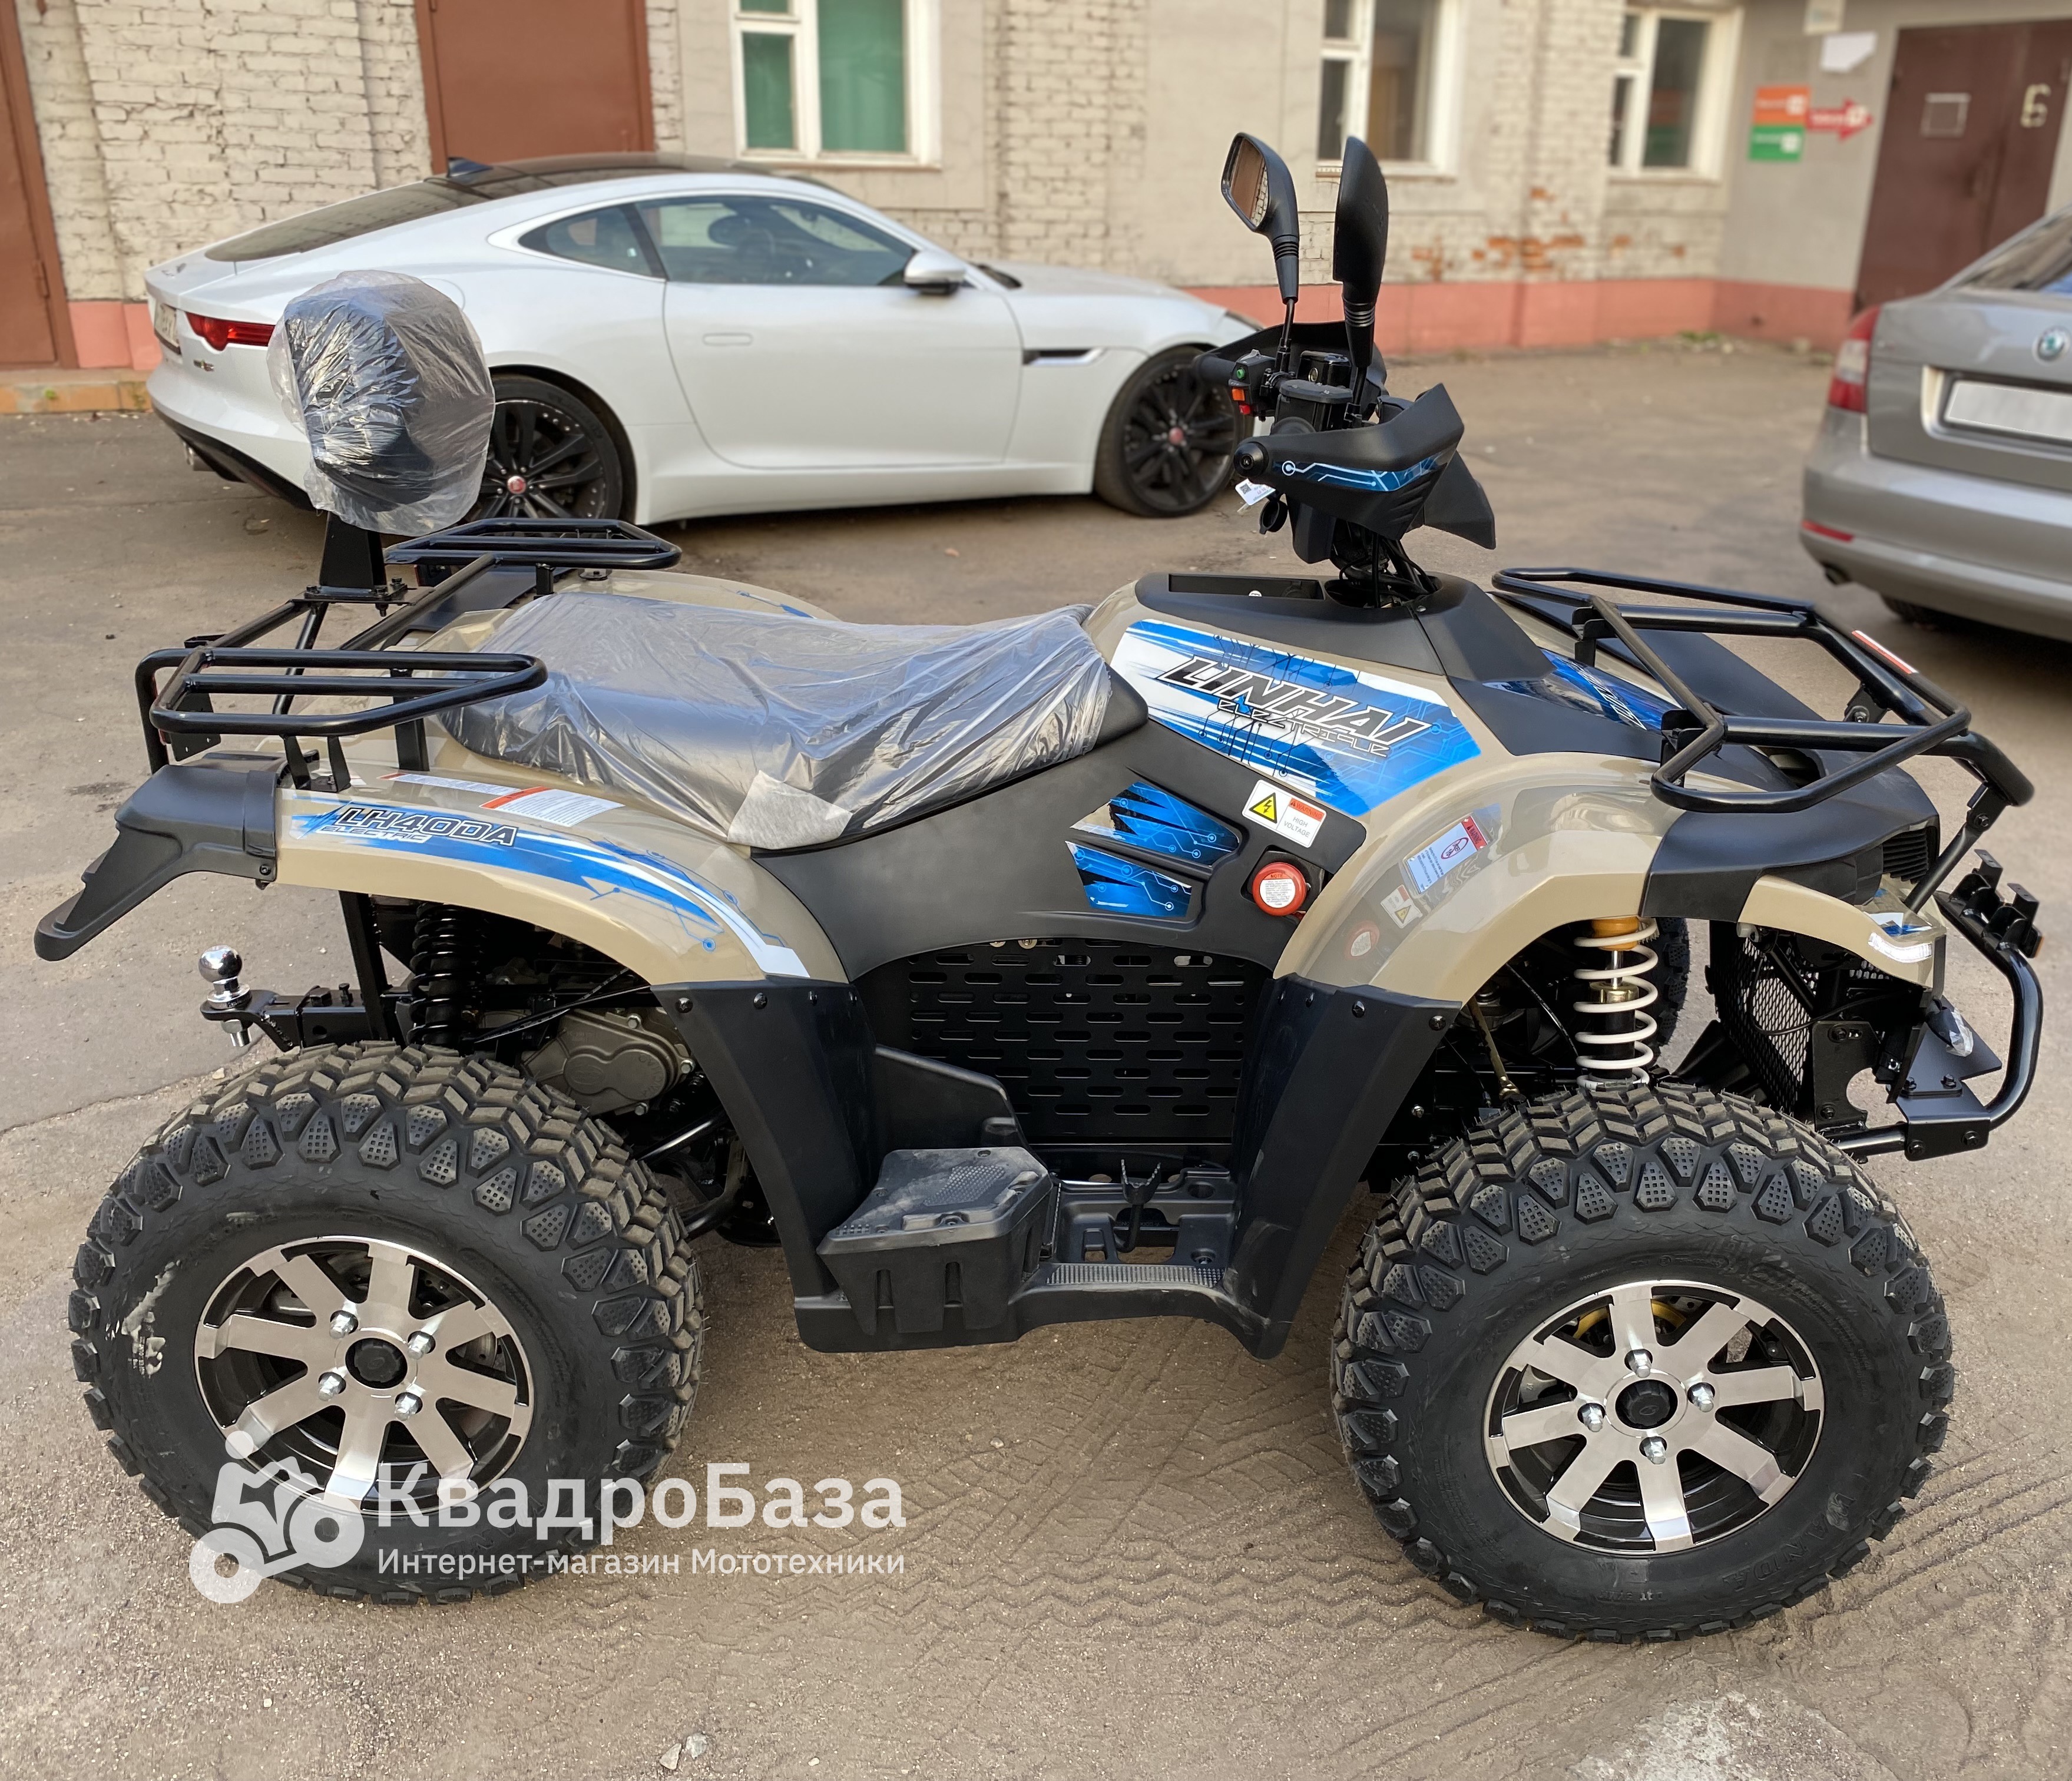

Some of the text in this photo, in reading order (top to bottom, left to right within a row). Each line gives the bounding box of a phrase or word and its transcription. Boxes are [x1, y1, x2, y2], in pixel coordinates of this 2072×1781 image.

[2020, 83, 2051, 128] 6
[1157, 655, 1434, 745] LINHAI
[1296, 803, 1323, 819] WARNING
[1284, 820, 1310, 837] VOLTAGE
[1293, 816, 1309, 827] HIGH
[318, 826, 432, 843] ELECTRIC
[1721, 1492, 1857, 1592] WANDA
